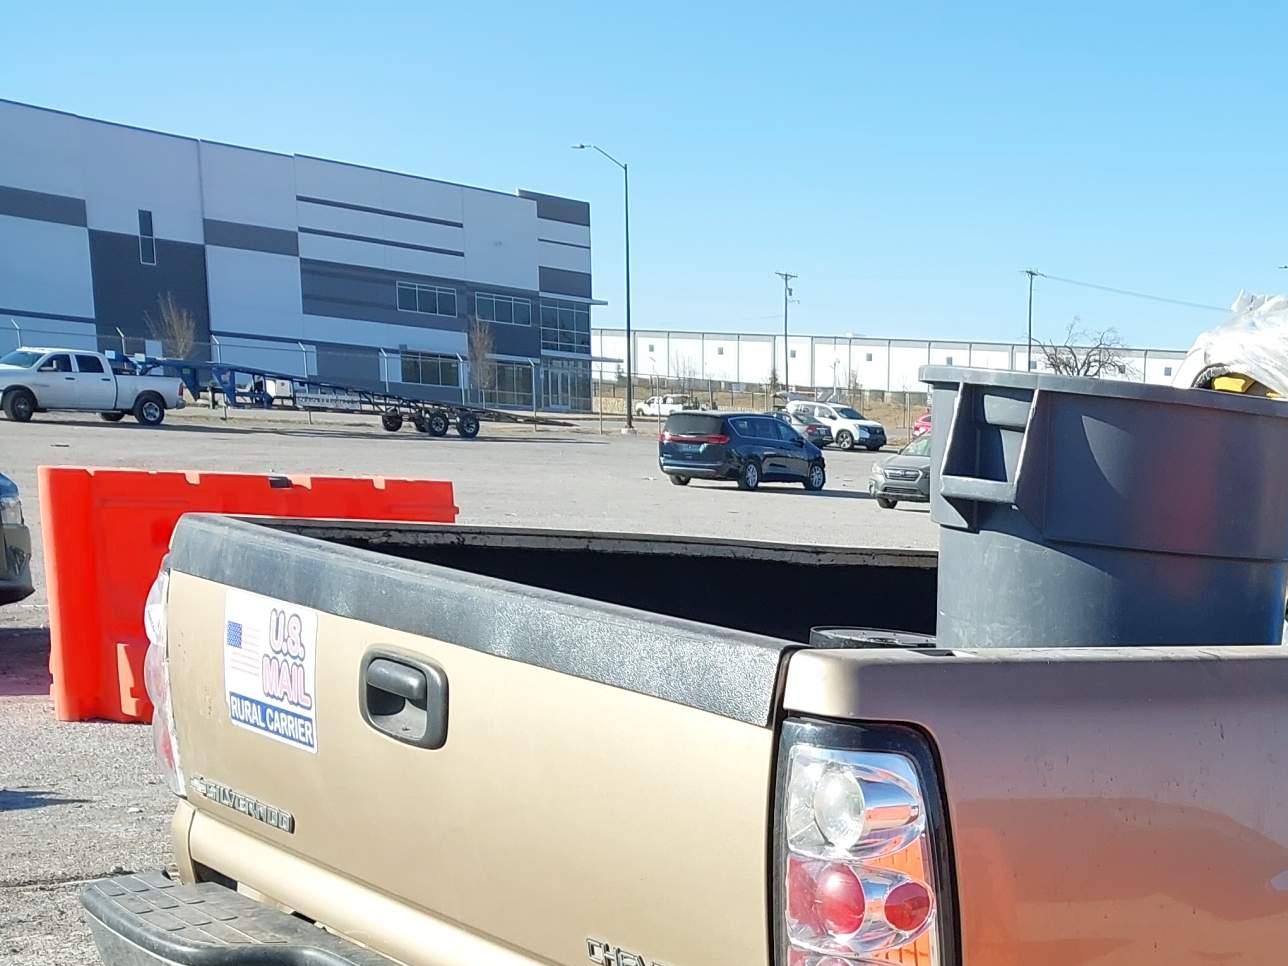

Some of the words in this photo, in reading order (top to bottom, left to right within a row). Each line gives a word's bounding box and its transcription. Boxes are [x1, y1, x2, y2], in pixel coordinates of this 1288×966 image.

[269, 608, 305, 660] U.S.
[262, 654, 312, 710] MAIL
[230, 695, 265, 728] RURAL
[265, 711, 313, 745] CARRIER
[206, 783, 295, 834] SILVERADO
